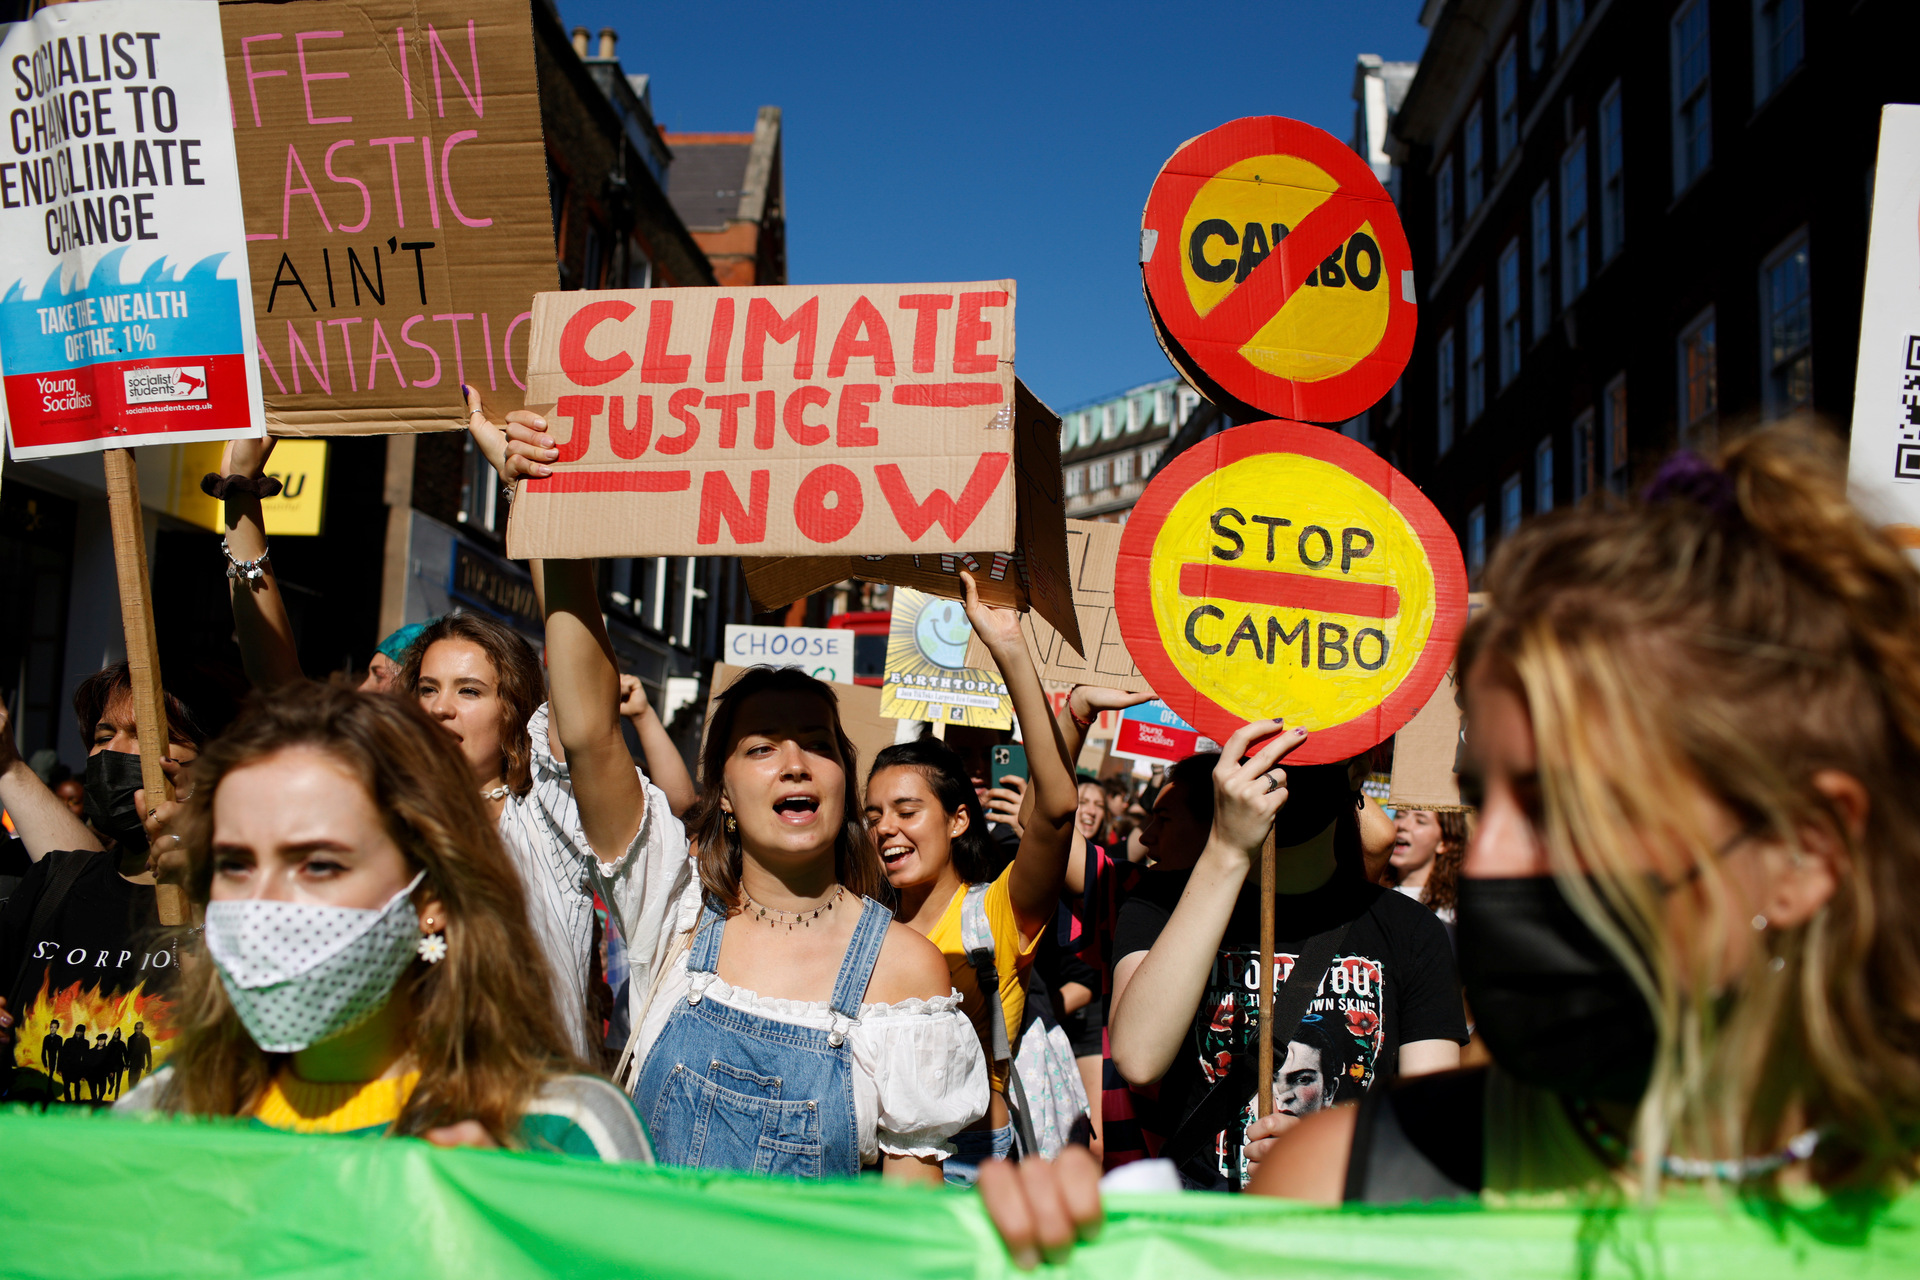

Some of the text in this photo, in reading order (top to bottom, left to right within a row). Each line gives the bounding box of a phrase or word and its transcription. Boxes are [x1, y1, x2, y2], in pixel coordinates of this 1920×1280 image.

[12, 32, 161, 102] SOCIALIST
[226, 19, 484, 128] FE IN
[10, 85, 178, 155] CHANGE TO
[0, 139, 205, 209] END CLIMATE
[45, 193, 159, 255] CHANGE
[267, 236, 436, 313] AIN'T
[1189, 218, 1382, 292] CABO
[37, 290, 188, 334] TAKE THE WEALTH
[64, 324, 156, 362] OFF THE 1%
[559, 290, 1009, 386] CLIMATE
[36, 377, 76, 397] Young
[128, 373, 172, 389] socialist
[129, 384, 176, 397] students
[133, 363, 151, 378] Join
[42, 390, 92, 413] Socialists
[125, 402, 213, 416] socialiststudents.org.uk
[556, 382, 882, 462] JUSTICE
[697, 451, 1010, 544] NOW
[1210, 507, 1375, 574] STOP
[732, 632, 839, 656] CHOOSE
[1184, 604, 1390, 671] CAMBO
[889, 671, 1009, 695] EARTHTOPIA
[1138, 723, 1164, 736] Young
[1160, 709, 1179, 725] OFF
[1138, 732, 1175, 747] Socialists
